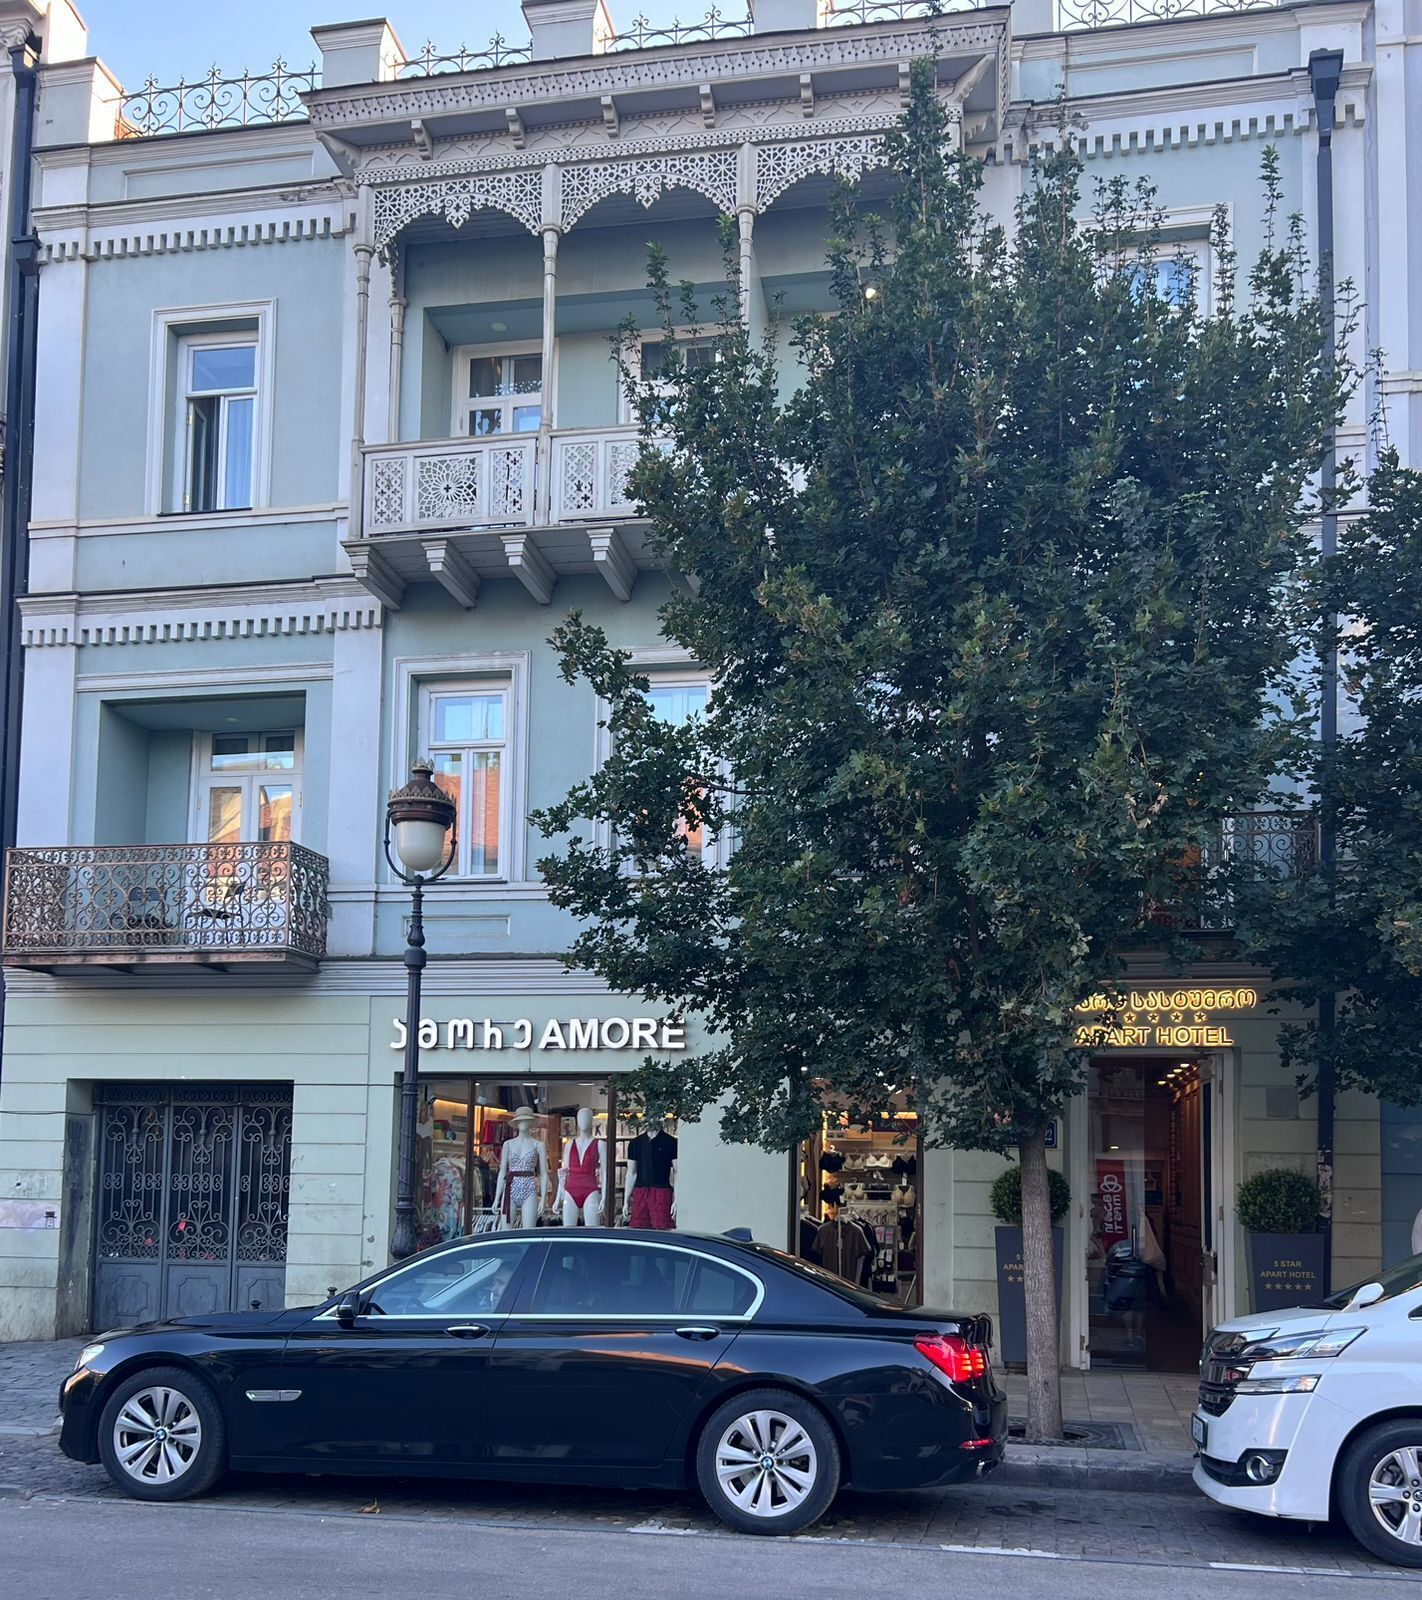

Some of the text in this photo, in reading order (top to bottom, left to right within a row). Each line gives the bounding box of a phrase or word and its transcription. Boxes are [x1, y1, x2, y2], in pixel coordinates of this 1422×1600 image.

[1131, 988, 1257, 1011] სასტუმრო
[390, 1018, 533, 1049] ამორე
[538, 1017, 686, 1049] AMORE
[1157, 1027, 1234, 1046] HOTEL
[1260, 1270, 1317, 1279] APART HOTEL
[1280, 1260, 1302, 1268] STAR
